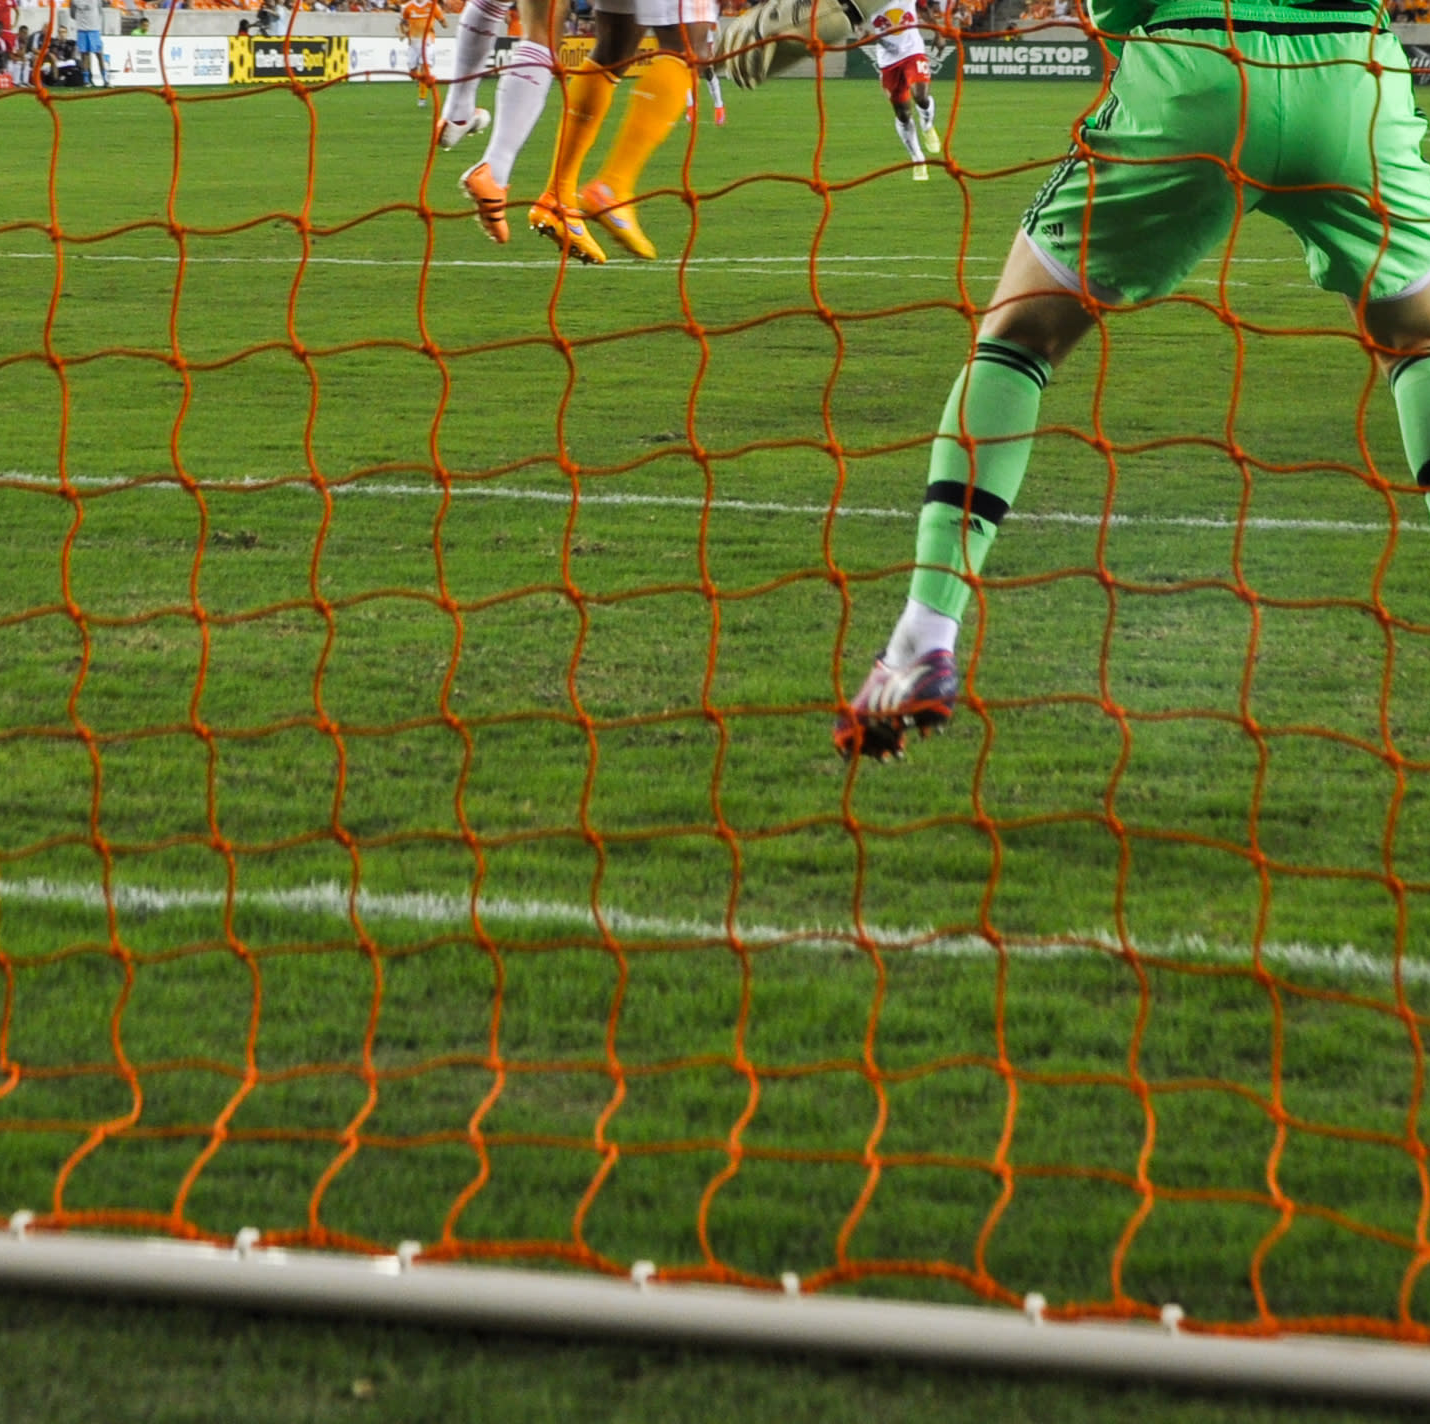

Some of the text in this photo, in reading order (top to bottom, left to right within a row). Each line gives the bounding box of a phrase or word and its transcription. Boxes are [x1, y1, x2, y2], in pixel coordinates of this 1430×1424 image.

[969, 46, 1089, 63] WINGSTOP
[963, 63, 1092, 75] THE WING EXPERTS
